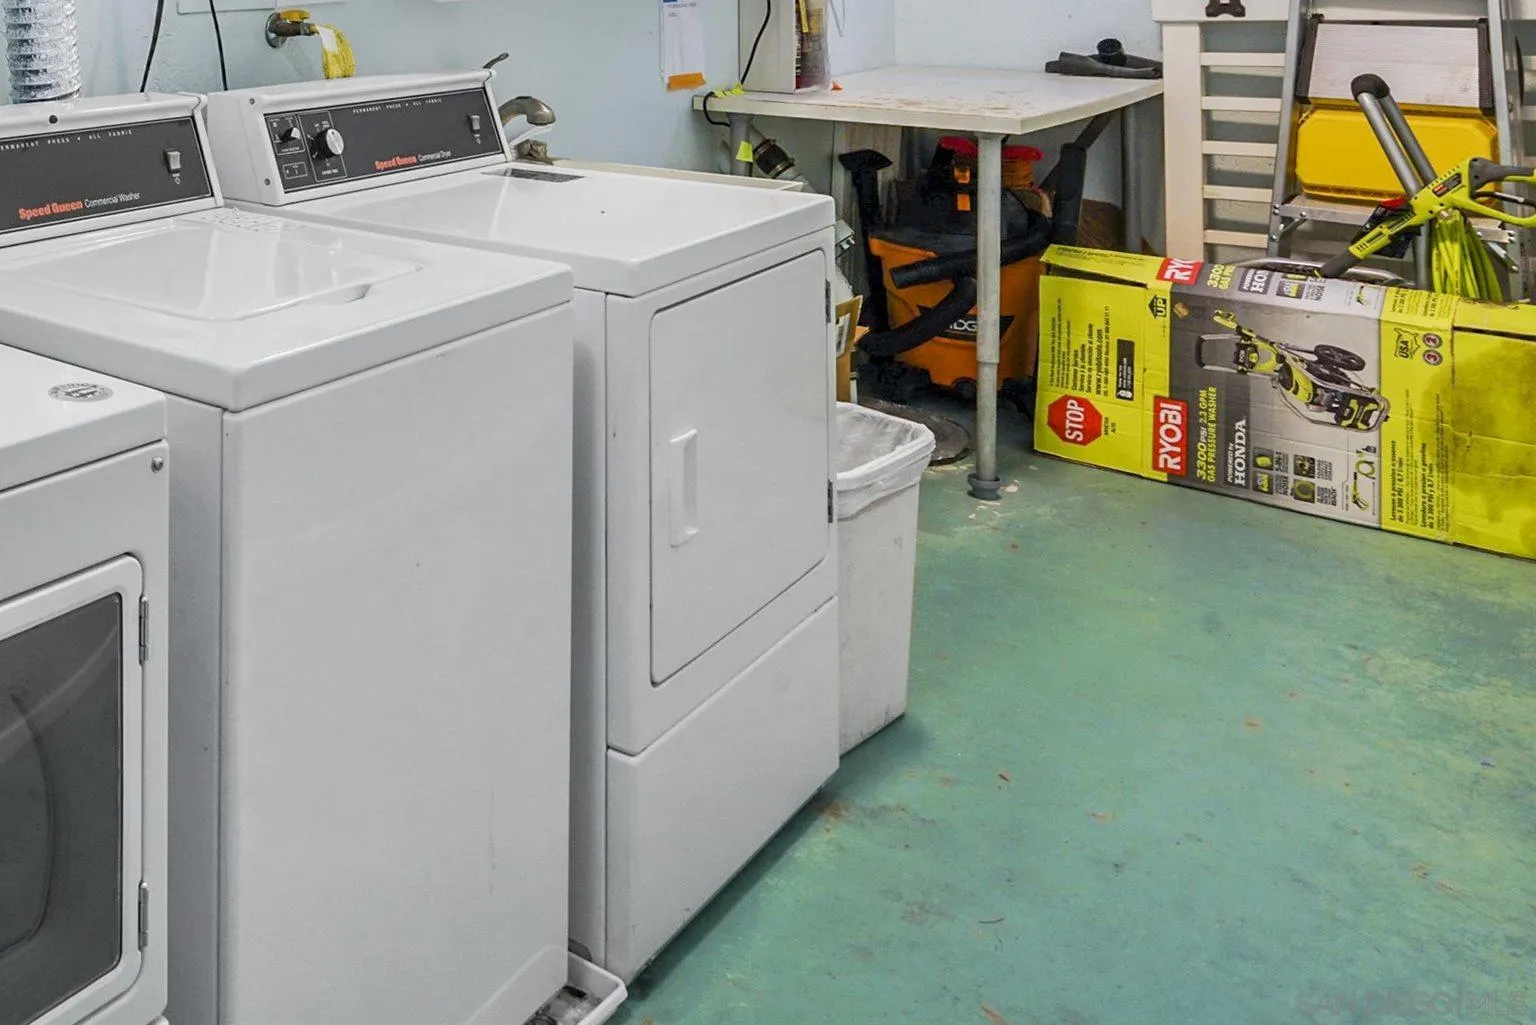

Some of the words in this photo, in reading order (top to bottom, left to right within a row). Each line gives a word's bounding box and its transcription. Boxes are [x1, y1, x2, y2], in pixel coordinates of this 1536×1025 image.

[374, 157, 396, 171] Speed
[419, 151, 441, 162] Commercial
[19, 204, 51, 221] Speed
[52, 200, 83, 213] Queen
[85, 195, 118, 208] Commercial
[119, 192, 140, 203] Washer
[1157, 298, 1165, 316] UP
[1398, 340, 1409, 358] USA
[1209, 386, 1217, 421] WASHER
[1065, 399, 1084, 441] STOP
[1199, 411, 1207, 424] 2.3
[1159, 402, 1182, 470] RYOBI
[1208, 423, 1217, 462] PRESSURE
[1228, 442, 1233, 450] by
[1235, 419, 1246, 486] HONDA
[1208, 464, 1216, 482] GAS
